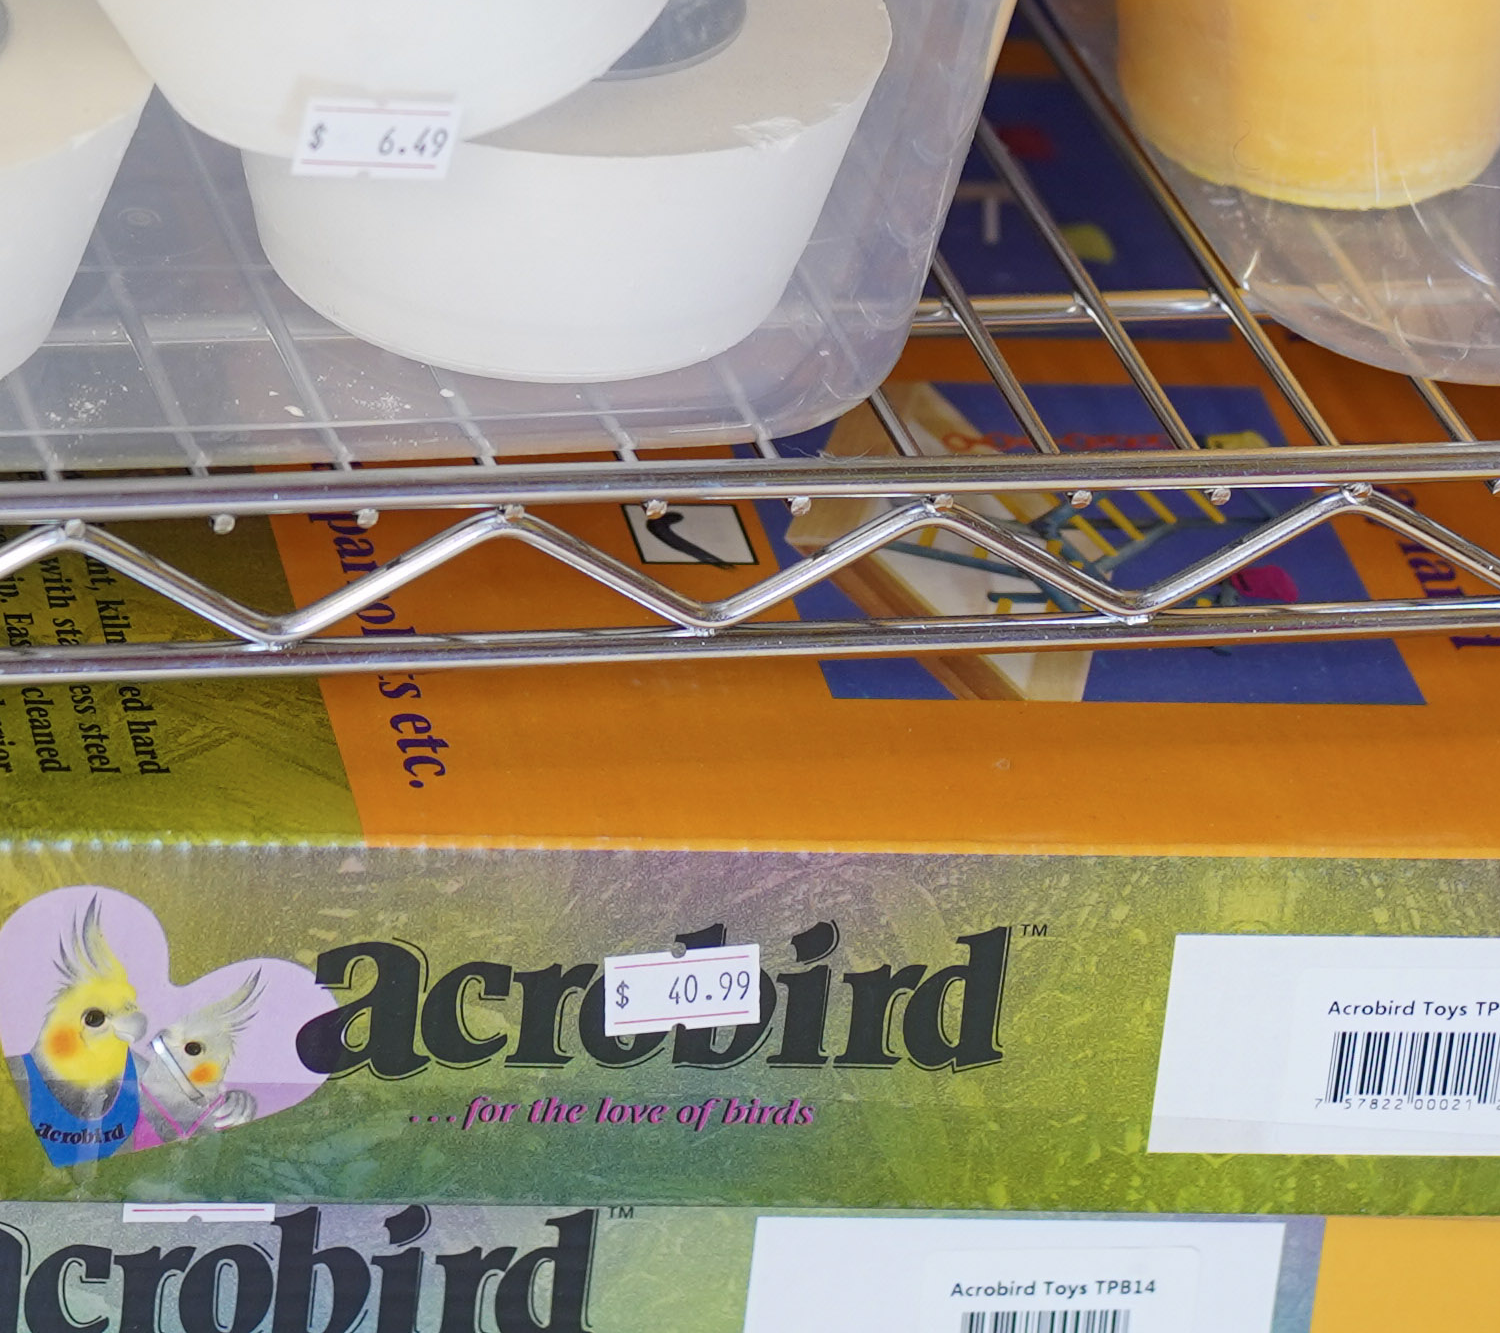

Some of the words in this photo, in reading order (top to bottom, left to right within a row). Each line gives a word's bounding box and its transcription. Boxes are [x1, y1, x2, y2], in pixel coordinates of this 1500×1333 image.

[309, 122, 327, 151] $
[378, 126, 449, 158] 6.49
[39, 556, 71, 610] with
[78, 723, 121, 773] steel
[21, 687, 72, 773] cleaned
[127, 719, 171, 775] hard
[390, 713, 450, 789] etc.
[615, 980, 630, 1009] $
[668, 971, 751, 1005] 40.99
[1328, 1000, 1416, 1016] Acrobird
[1423, 1001, 1468, 1021] Toys
[528, 1097, 588, 1125] the
[596, 1097, 668, 1125] love
[677, 1097, 722, 1132] of
[722, 1098, 816, 1126] birds
[950, 1280, 1036, 1297] Acrobird
[1043, 1281, 1088, 1300] Toys
